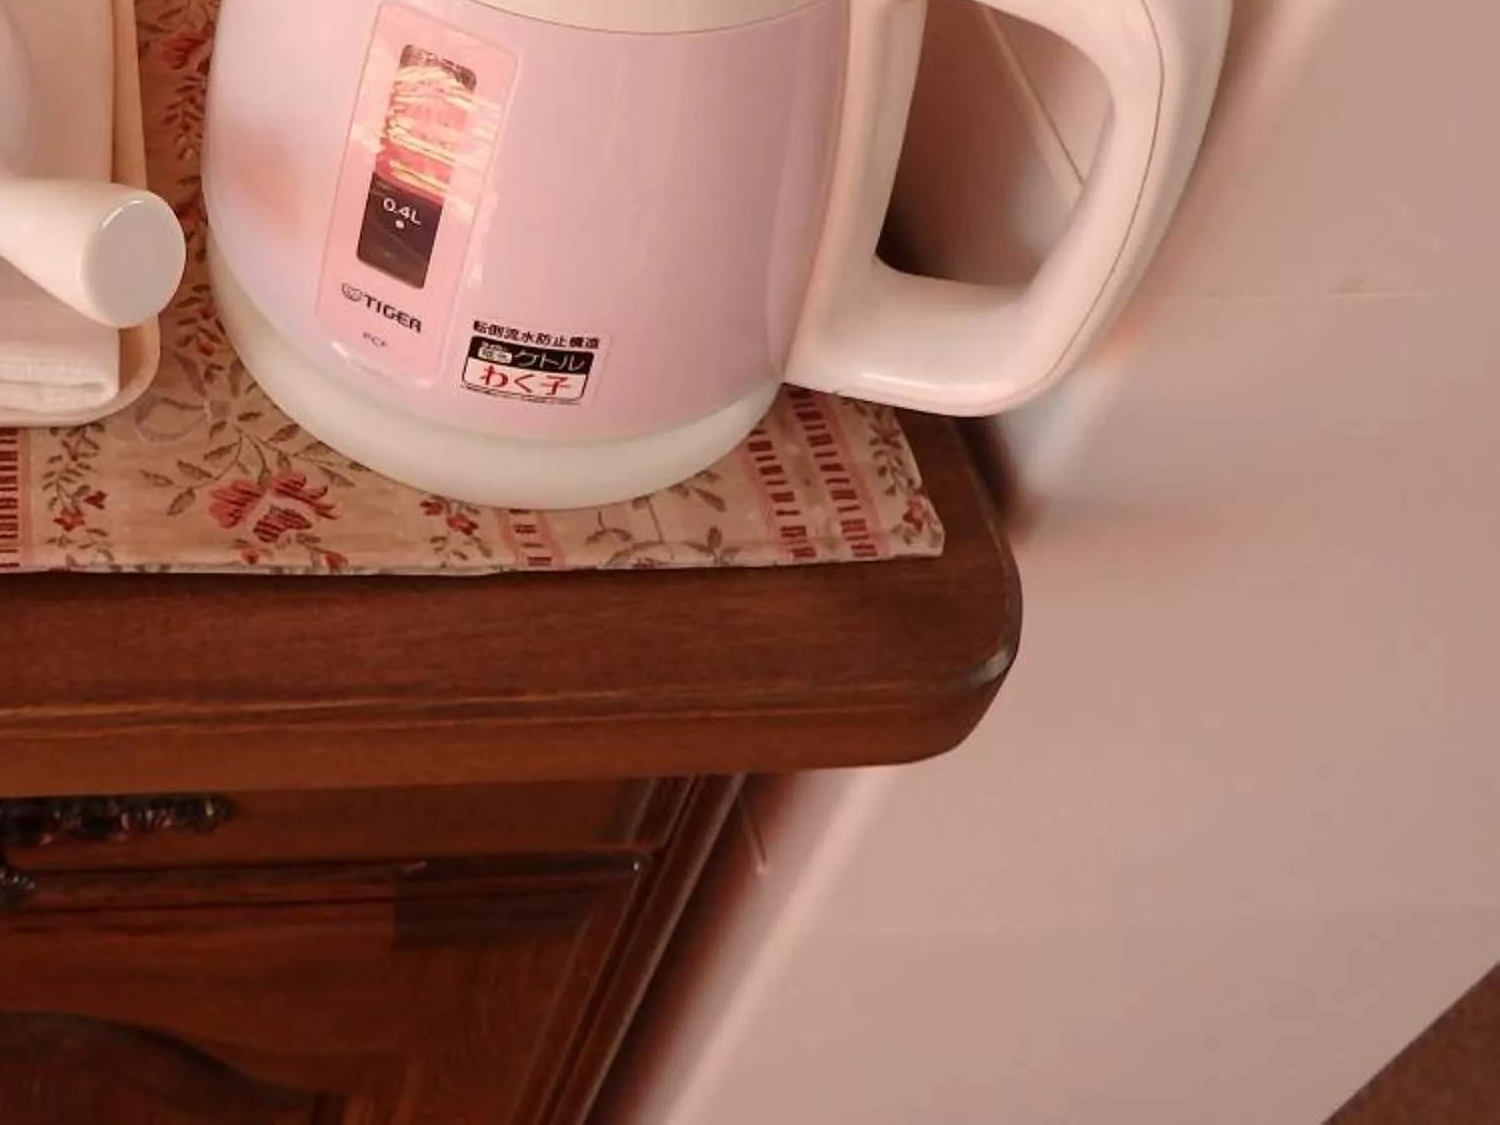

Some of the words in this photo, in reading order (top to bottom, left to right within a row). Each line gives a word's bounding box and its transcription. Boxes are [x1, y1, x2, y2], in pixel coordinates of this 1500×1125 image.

[383, 197, 421, 226] 0.4L
[363, 293, 422, 334] TIGER
[480, 364, 571, 396] わく子
